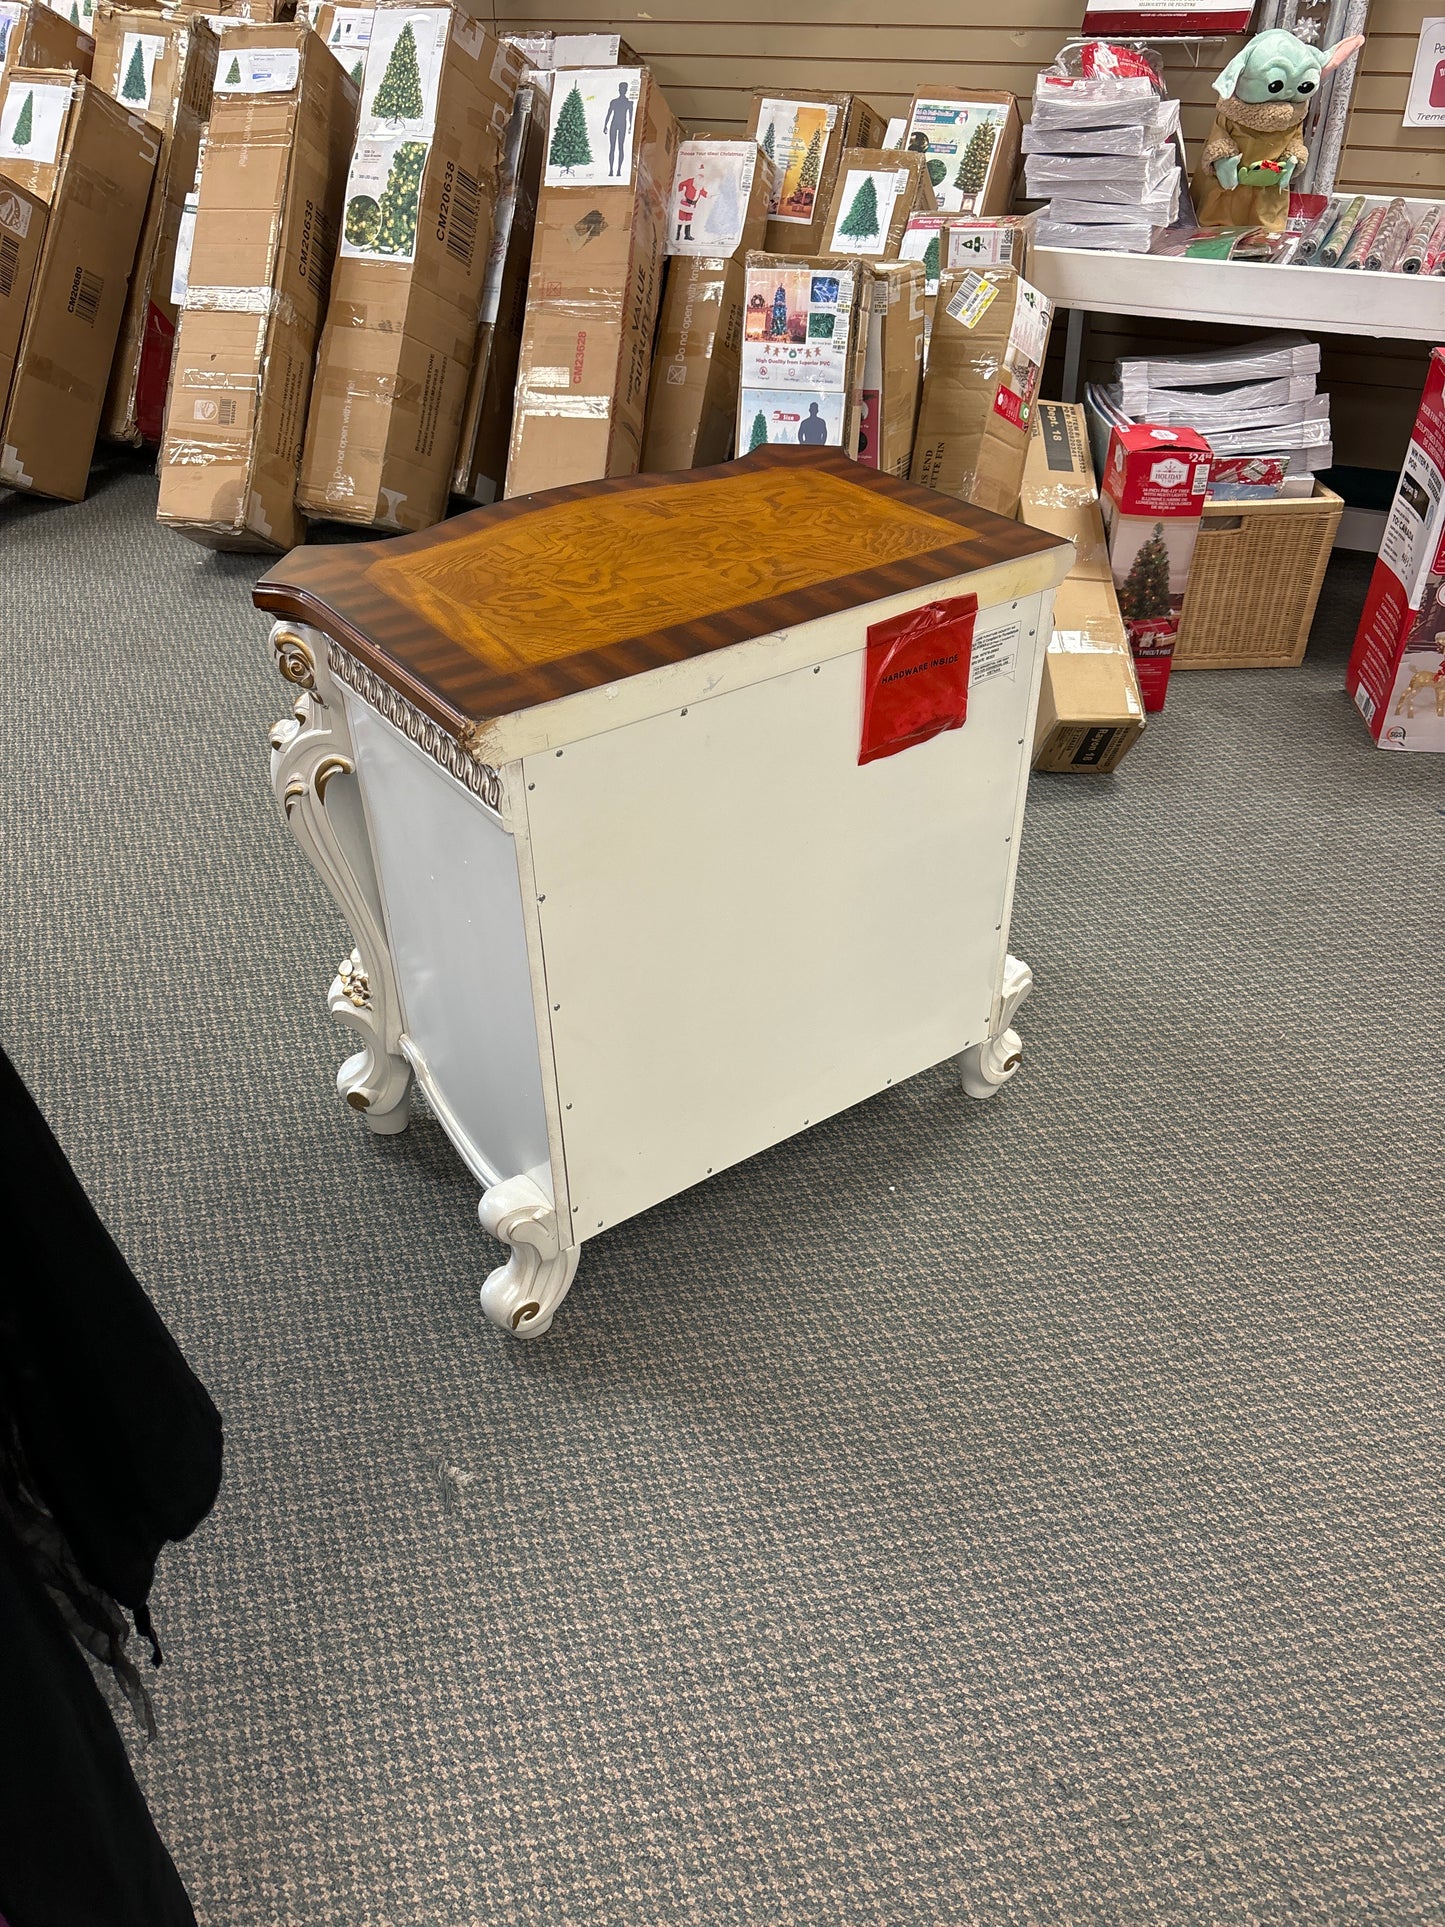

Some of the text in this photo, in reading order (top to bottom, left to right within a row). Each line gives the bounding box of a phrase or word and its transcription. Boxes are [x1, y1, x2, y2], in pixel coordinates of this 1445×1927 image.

[436, 161, 455, 241] CM20638
[298, 200, 314, 277] CM20638
[67, 266, 83, 313] CM20680
[632, 264, 646, 331] VALUE
[682, 305, 696, 329] open
[634, 305, 650, 394] QUALITY
[680, 329, 688, 346] not
[573, 331, 587, 384] CM23628
[675, 348, 686, 362] Do
[340, 404, 351, 424] with
[1046, 405, 1063, 441] Dept. 18
[1071, 416, 1079, 431] ITEM
[337, 424, 351, 449] open
[334, 449, 345, 464] not
[923, 449, 933, 472] END
[935, 441, 945, 460] FIN
[332, 464, 343, 479] Do
[1399, 520, 1414, 541] CANADA
[881, 662, 929, 684] HARDWARE
[930, 653, 959, 667] INSIDE
[1082, 728, 1109, 762] Rayon 18
